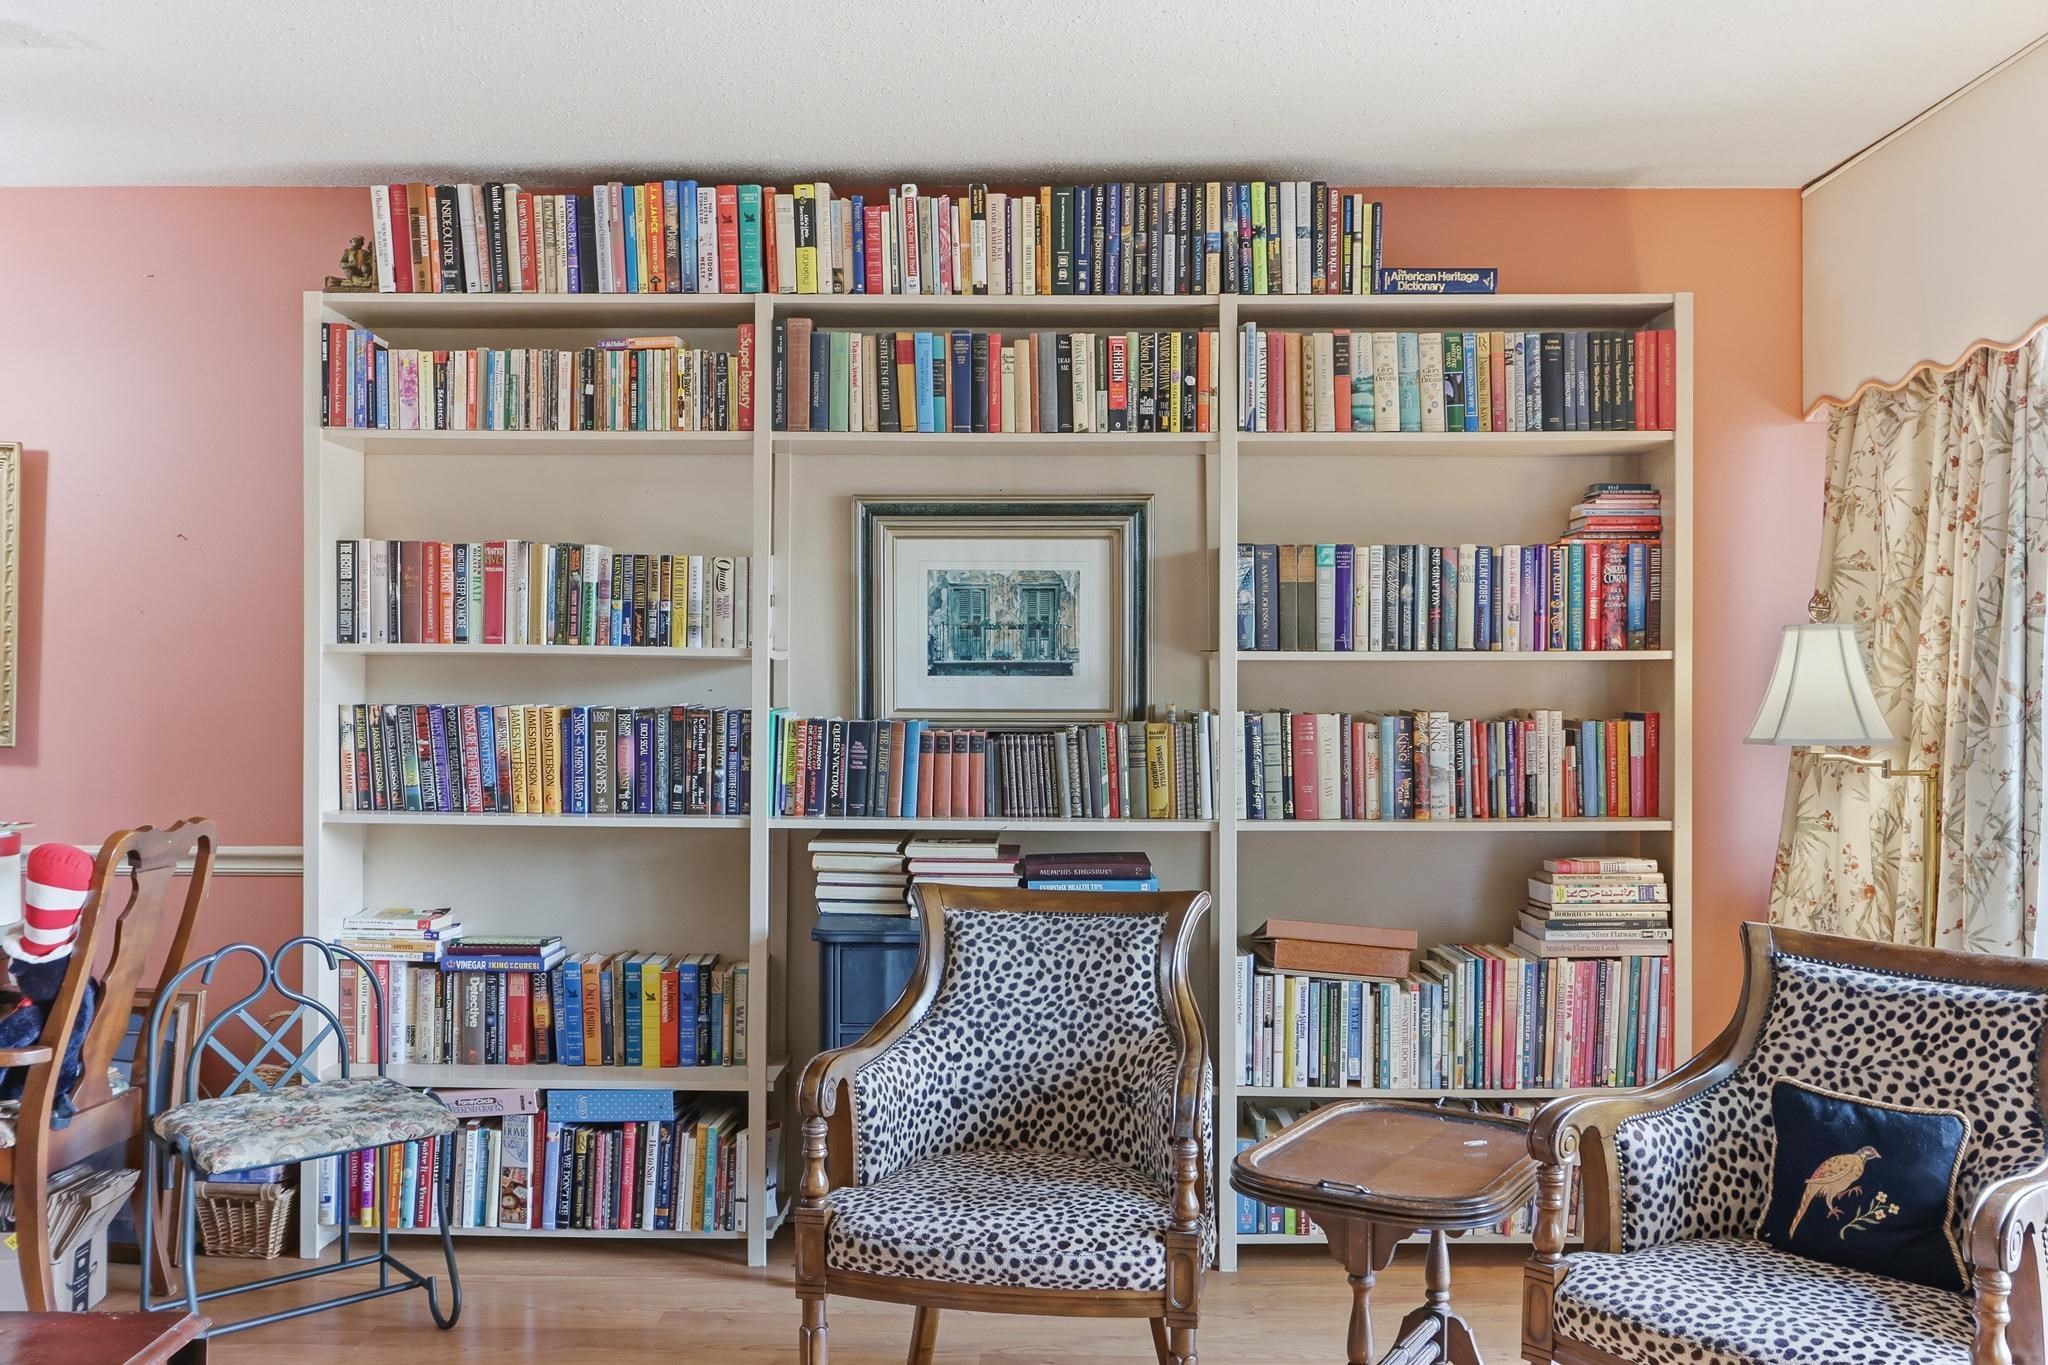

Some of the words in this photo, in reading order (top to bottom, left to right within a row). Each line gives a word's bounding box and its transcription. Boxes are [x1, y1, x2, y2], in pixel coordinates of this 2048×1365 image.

[1390, 271, 1437, 282] American
[1438, 271, 1479, 284] Heritage
[1397, 281, 1446, 293] Dictionary
[739, 338, 752, 369] Super
[880, 339, 889, 376] STREETS
[1111, 343, 1124, 382] CHABON
[1140, 335, 1154, 361] Nelson
[739, 370, 753, 409] Beauty
[882, 377, 889, 387] OF
[1140, 362, 1154, 392] DeMille
[882, 388, 890, 410] GOLD
[1479, 548, 1489, 577] HARLAN
[1478, 579, 1488, 605] COBEN
[463, 708, 475, 730] ROSES
[478, 711, 490, 738] JAMES
[510, 709, 520, 738] JAMES
[527, 710, 536, 737] JAMES
[544, 711, 553, 738] JAMES
[573, 713, 585, 736] STARS
[465, 732, 476, 746] ARE
[698, 718, 706, 751] Collected
[832, 723, 841, 755] QUEEN
[1430, 717, 1441, 752] KING
[466, 748, 477, 760] RED
[482, 738, 493, 787] PATTERSON
[512, 739, 523, 793] PATTERSON
[528, 737, 538, 786] PATTERSON
[545, 738, 555, 787] PATTERSON
[468, 767, 480, 806] PATTERSON
[830, 756, 840, 798] VICTORIA
[1150, 760, 1160, 789] MURDERS
[1040, 868, 1072, 876] MEMPHIS
[455, 959, 486, 970] VINEGAR
[700, 973, 708, 996] Daniel
[469, 977, 480, 1028] Detective
[1566, 985, 1574, 1019] FIESTA
[503, 1128, 528, 1137] HOME
